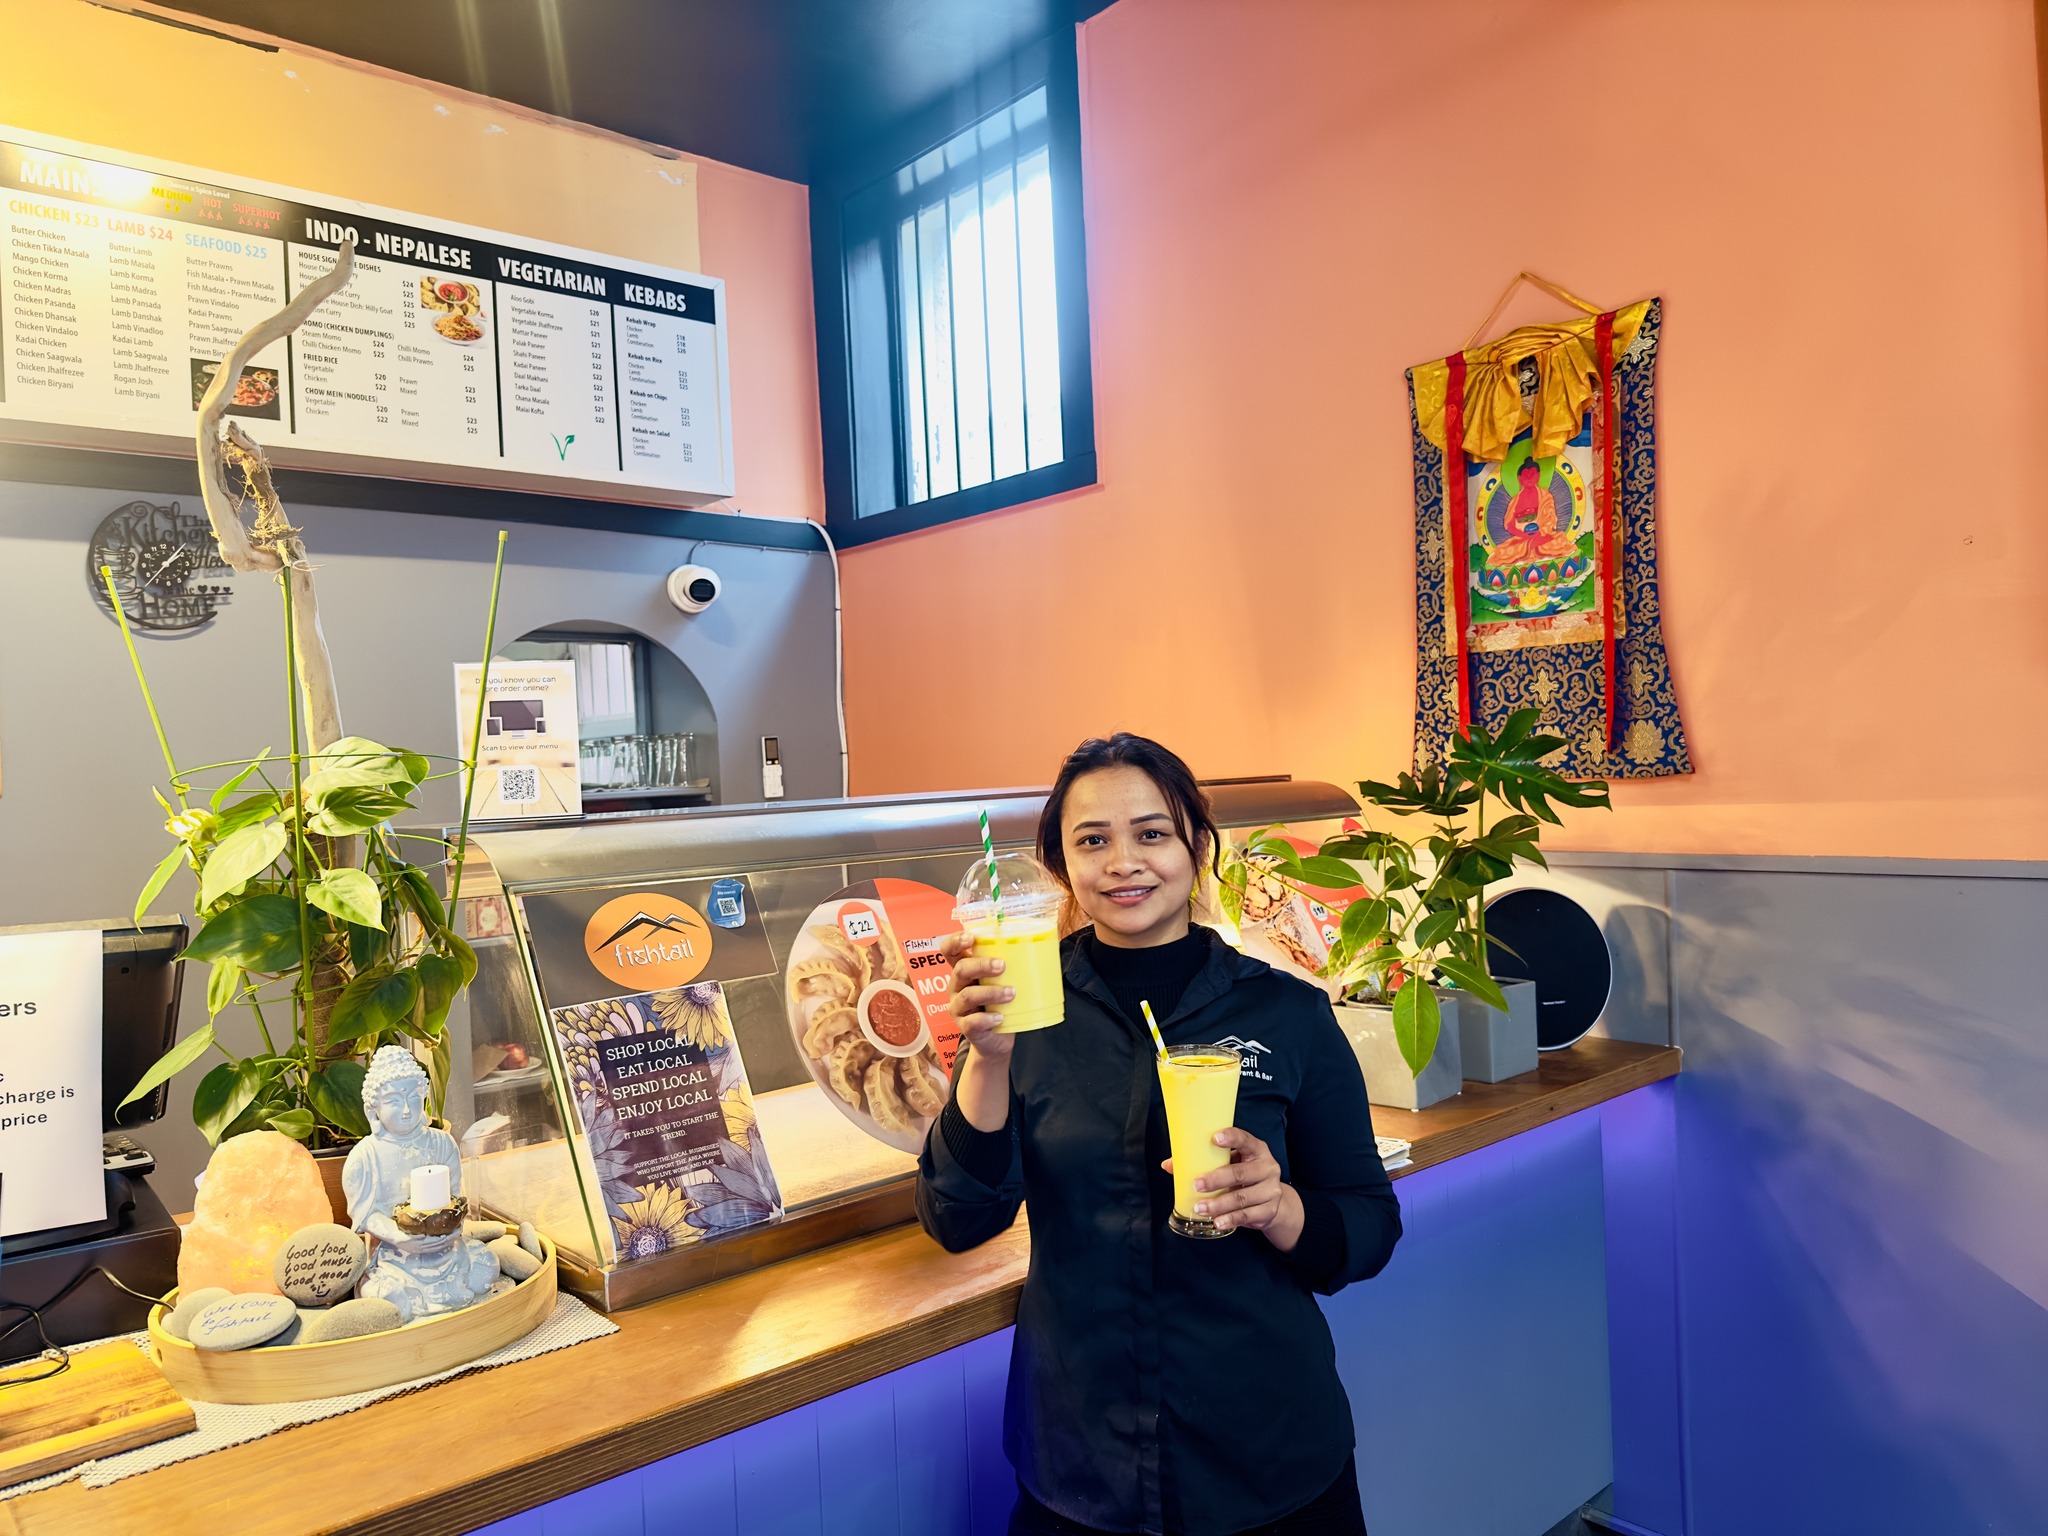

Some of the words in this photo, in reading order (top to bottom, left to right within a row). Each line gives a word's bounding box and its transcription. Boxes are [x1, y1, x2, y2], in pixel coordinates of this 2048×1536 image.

[152, 187, 192, 203] MEDIUM
[213, 190, 230, 199] Level
[204, 198, 222, 209] HOT
[10, 200, 70, 222] CHICKEN
[74, 212, 98, 227] $23
[233, 204, 281, 221] SUPERHOT
[12, 225, 35, 235] Butter
[37, 230, 66, 241] Chicken
[108, 216, 145, 236] LAMB
[150, 226, 173, 241] $24
[12, 239, 40, 250] Chicken
[43, 244, 62, 253] Tikka
[64, 248, 89, 258] Masala
[185, 234, 241, 254] SEAFOOD
[245, 244, 267, 259] $25
[305, 218, 359, 248] INDO
[375, 232, 471, 270] NEPALESE
[13, 253, 39, 264] Mango
[41, 257, 68, 268] Chicken
[110, 256, 129, 265] Lamb
[131, 260, 155, 270] Masala
[186, 257, 207, 266] Butter
[209, 261, 233, 271] Prawns
[299, 252, 320, 261] HOUSE
[359, 262, 381, 272] DISHES
[13, 266, 42, 277] Chicken
[44, 271, 68, 281] Korma
[498, 257, 606, 296] VEGETARIAN
[13, 280, 42, 291] Chicken
[45, 285, 71, 295] Madras
[14, 294, 43, 304] Chicken
[45, 298, 75, 309] Pasanda
[188, 296, 209, 304] Prawn
[211, 299, 239, 309] Vindaloo
[624, 283, 686, 312] KEBABS
[14, 307, 43, 318] Chicken
[46, 312, 76, 323] Dhansak
[188, 308, 207, 316] Kadai
[209, 311, 232, 321] Prawns
[15, 321, 44, 331] Chicken
[46, 325, 78, 336] Vindaloo
[302, 329, 321, 338] Steam
[323, 333, 341, 342] Momo
[324, 323, 353, 333] (CHICKEN
[355, 328, 394, 340] DUMPLINGS)
[16, 335, 36, 344] Kadai
[39, 338, 67, 348] Chicken
[113, 335, 132, 344] Kadai
[134, 338, 153, 346] Lamb
[16, 348, 45, 358] Chicken
[47, 352, 82, 363] Saagwala
[304, 353, 322, 362] FRIED
[17, 362, 45, 372] Chicken
[47, 366, 84, 377] Jhalfrezee
[17, 376, 46, 386] Chicken
[48, 379, 74, 389] Biryani
[114, 374, 136, 384] Rogan
[138, 377, 153, 385] Josh
[115, 387, 134, 396] Lamb
[136, 390, 160, 399] Biryani
[305, 387, 324, 395] CHOW
[326, 390, 343, 398] MEIN
[345, 392, 378, 403] (NOODLES)
[849, 920, 874, 936] $22
[615, 939, 694, 968] fishtail
[909, 953, 946, 969] SPEC
[0, 1002, 37, 1017] ers
[606, 1042, 644, 1061] SHOP
[647, 1034, 694, 1053] LOCAL
[617, 1063, 644, 1079] EAT
[647, 1054, 692, 1073] LOCAL
[1241, 1054, 1258, 1068] ail
[1262, 1072, 1273, 1081] Bar
[612, 1080, 659, 1100] SPEND
[662, 1071, 707, 1090] LOCAL
[0, 1090, 56, 1105] charge
[61, 1086, 74, 1098] is
[617, 1099, 662, 1120] ENJOY
[667, 1089, 712, 1109] LOCAL
[1, 1113, 48, 1130] price
[632, 1127, 654, 1138] TAKES
[655, 1123, 670, 1132] YOU
[682, 1116, 704, 1126] START
[704, 1112, 719, 1121] THE
[661, 1130, 687, 1141] TREND.
[634, 1159, 658, 1168] SUPPORT
[659, 1154, 670, 1162] THE
[670, 1150, 688, 1160] LOCAL
[689, 1143, 720, 1155] BUSINESSES
[637, 1167, 650, 1176] WHO
[651, 1162, 674, 1172] SUPPORT
[676, 1158, 687, 1166] THE
[688, 1154, 702, 1163] AREA
[703, 1150, 721, 1158] WHERE
[660, 1169, 672, 1177] LIVE
[672, 1166, 689, 1174] WORK
[287, 1244, 318, 1262] Good
[321, 1243, 348, 1257] food
[285, 1259, 317, 1276] Good
[320, 1255, 352, 1266] music
[285, 1273, 316, 1289] Good
[318, 1268, 351, 1279] mood
